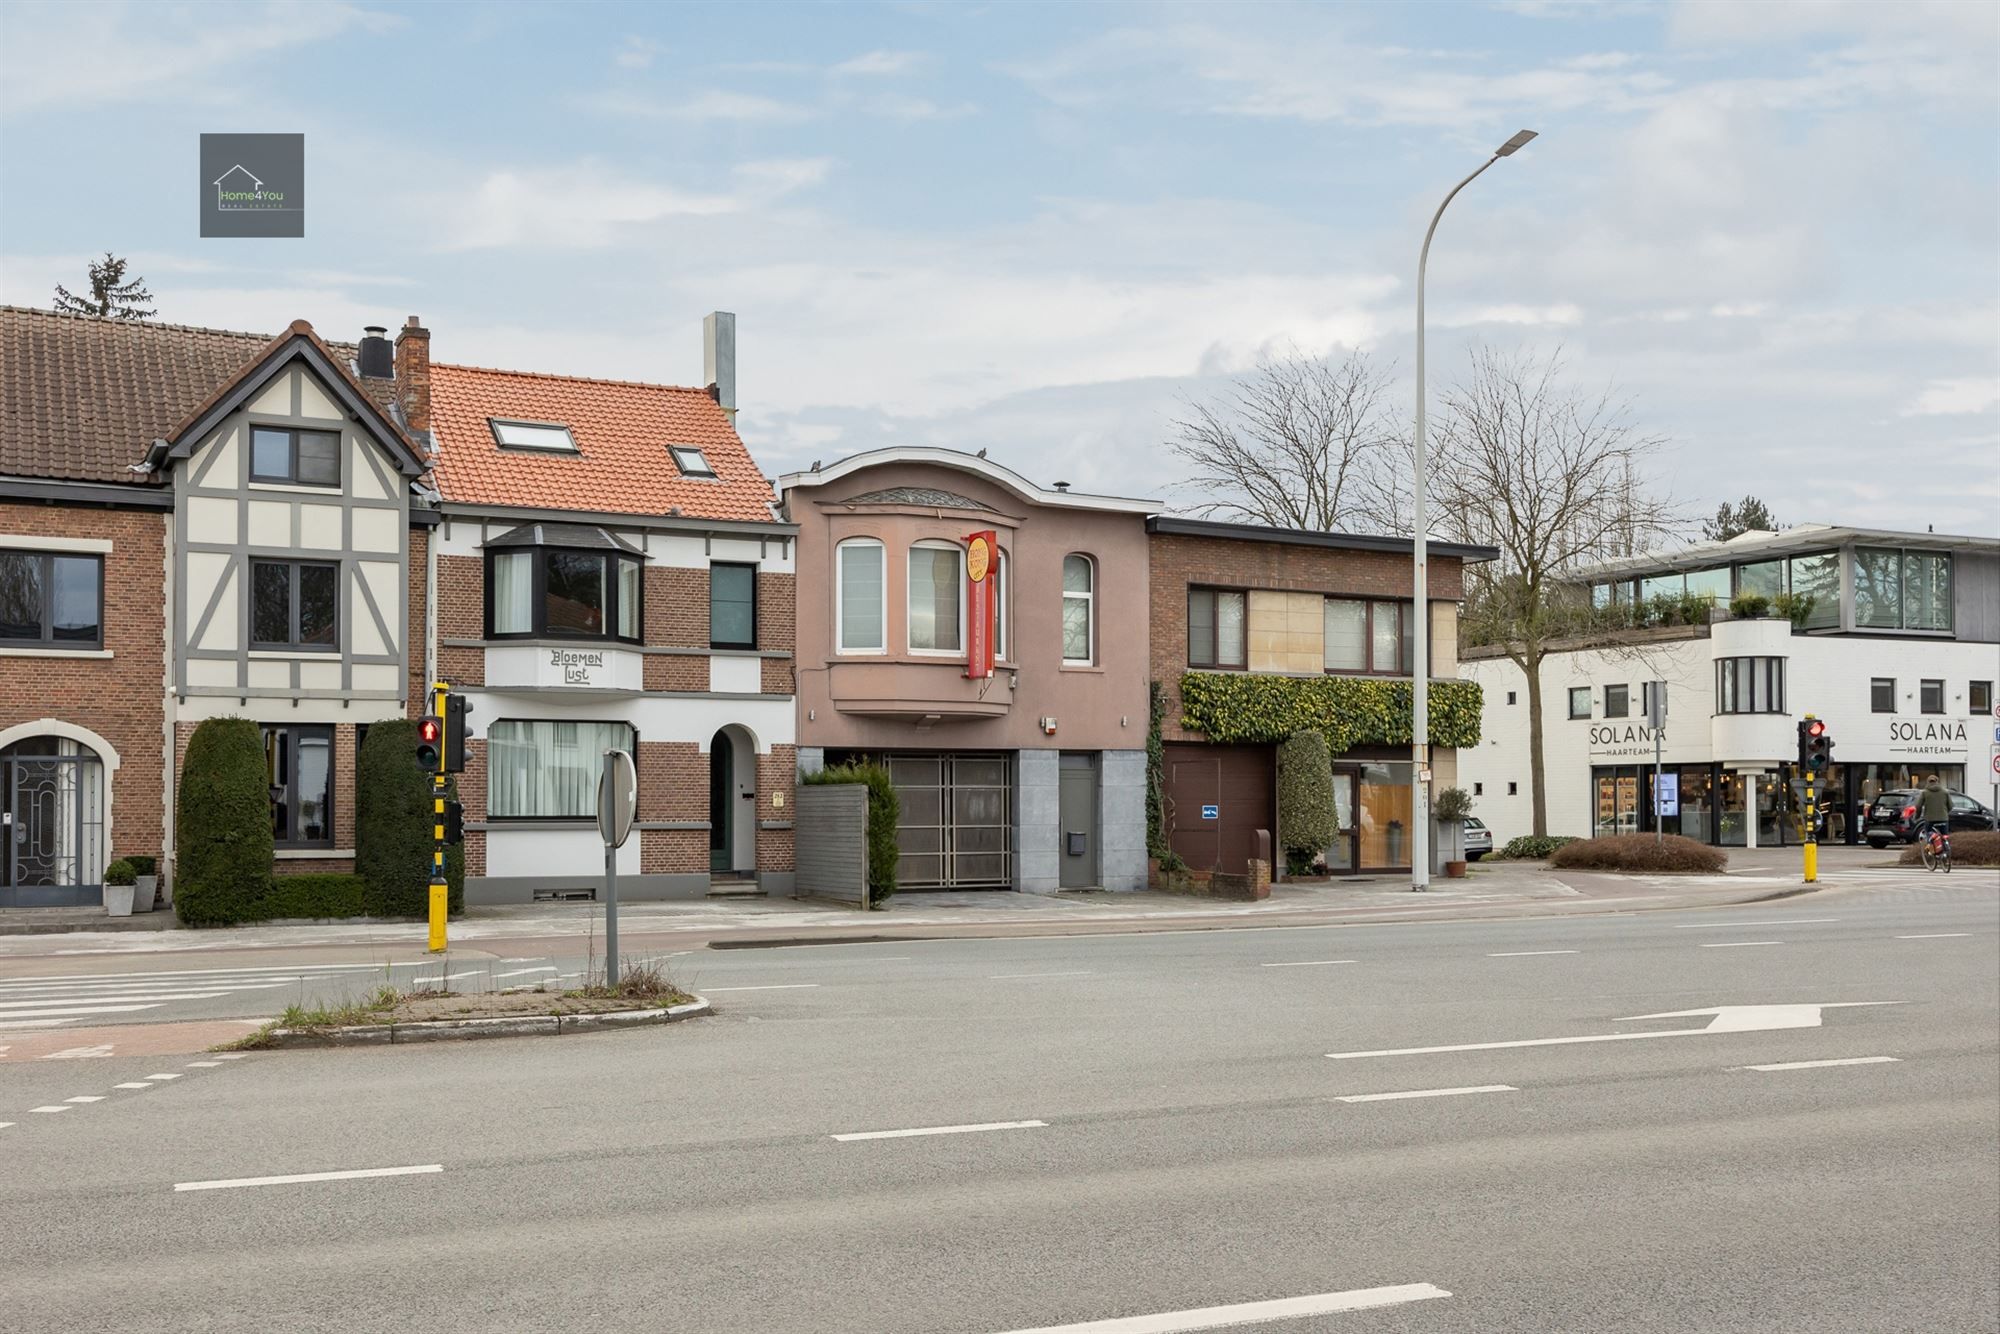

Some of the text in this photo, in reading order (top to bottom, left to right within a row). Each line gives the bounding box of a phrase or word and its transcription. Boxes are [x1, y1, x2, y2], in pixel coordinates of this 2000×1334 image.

[565, 666, 590, 685] Lust
[1590, 725, 1667, 744] SOLANA
[1890, 722, 1967, 741] SOLANA
[1606, 748, 1650, 756] HAARTEAM
[1906, 746, 1952, 754] HAARTEAM
